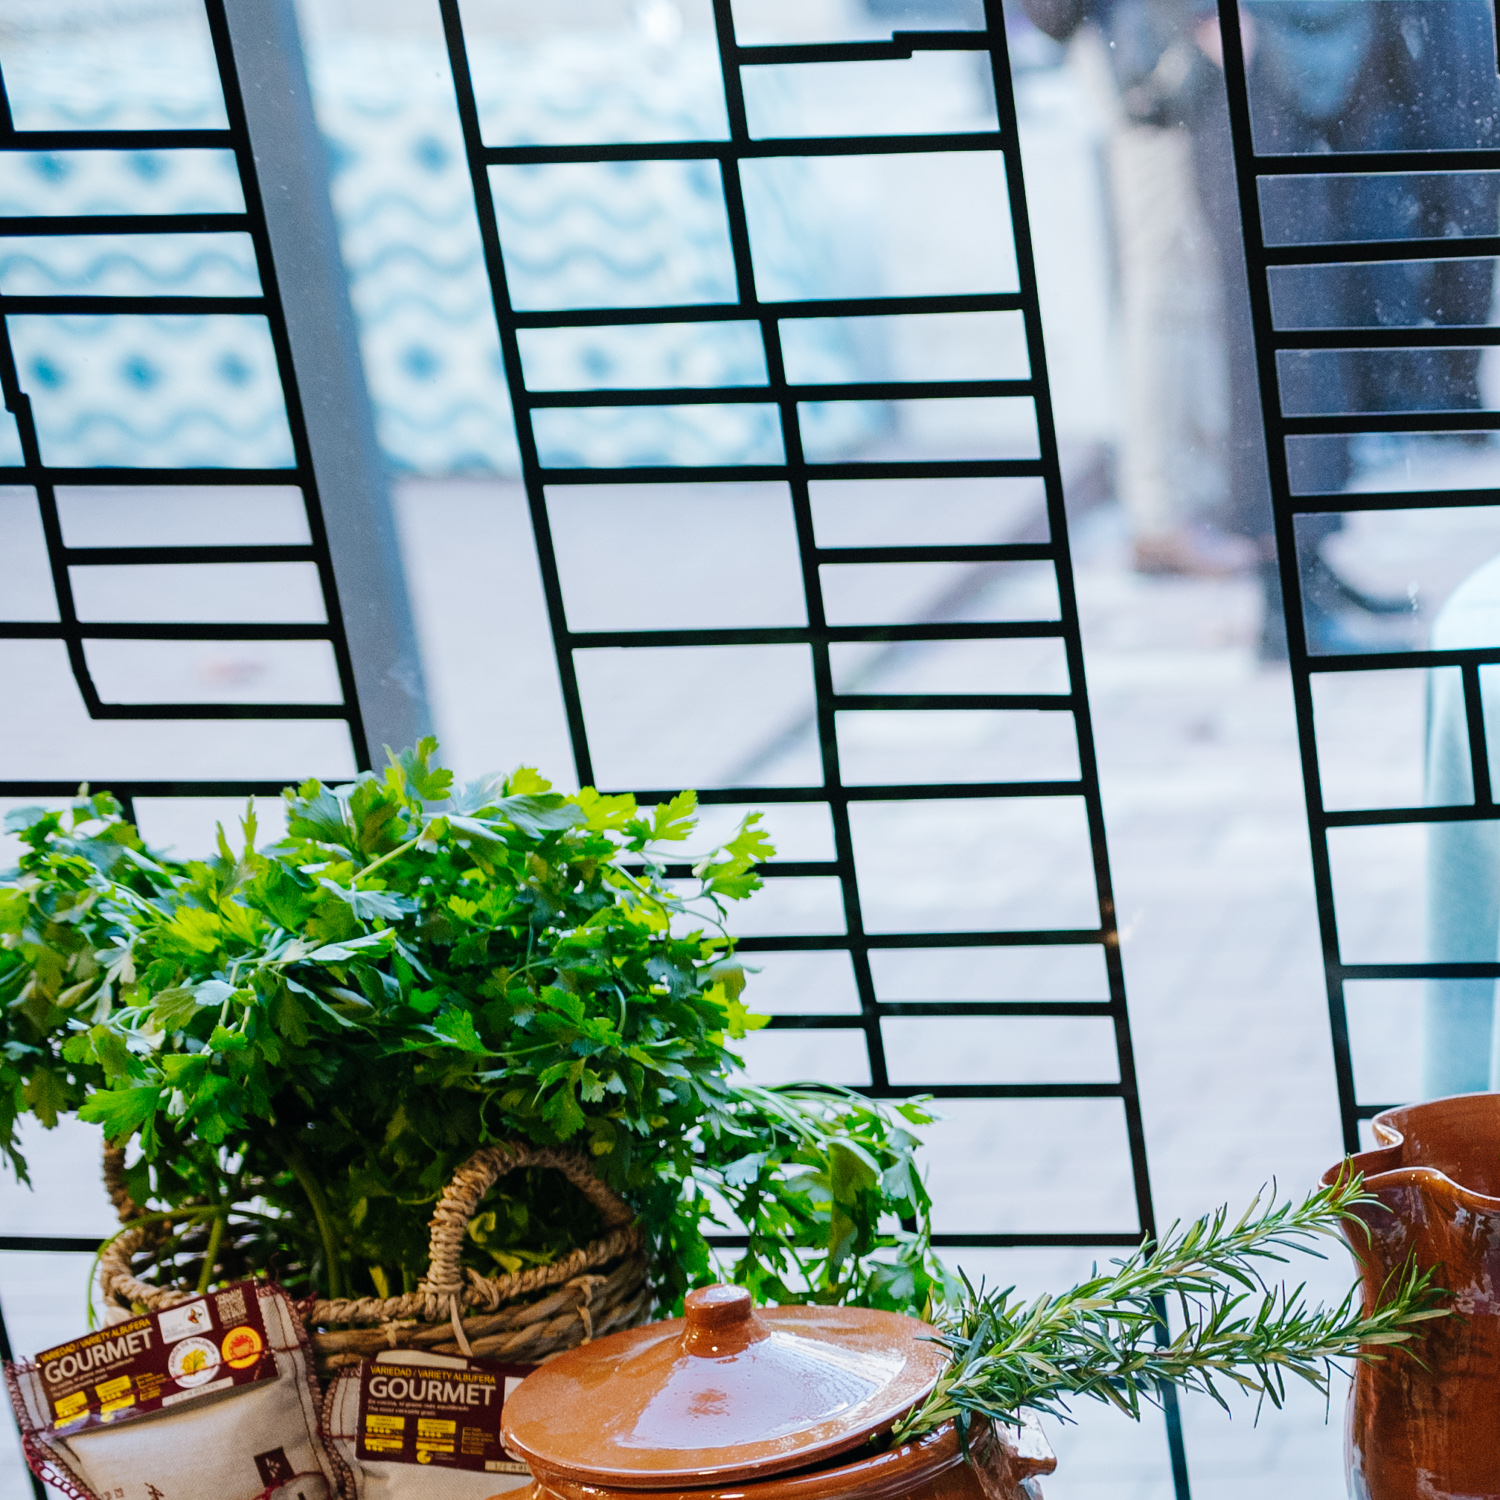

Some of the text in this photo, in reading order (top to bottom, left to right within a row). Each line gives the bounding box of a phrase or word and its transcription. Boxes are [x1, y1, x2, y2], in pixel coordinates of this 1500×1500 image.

[80, 1328, 112, 1349] VARIETY
[110, 1318, 151, 1339] ALBUFERA
[44, 1328, 153, 1384] GOURMET
[370, 1365, 412, 1377] VARIEDAD
[418, 1371, 451, 1381] VARIETY
[453, 1374, 496, 1384] ALBUFERA
[368, 1376, 497, 1406] GOURMET
